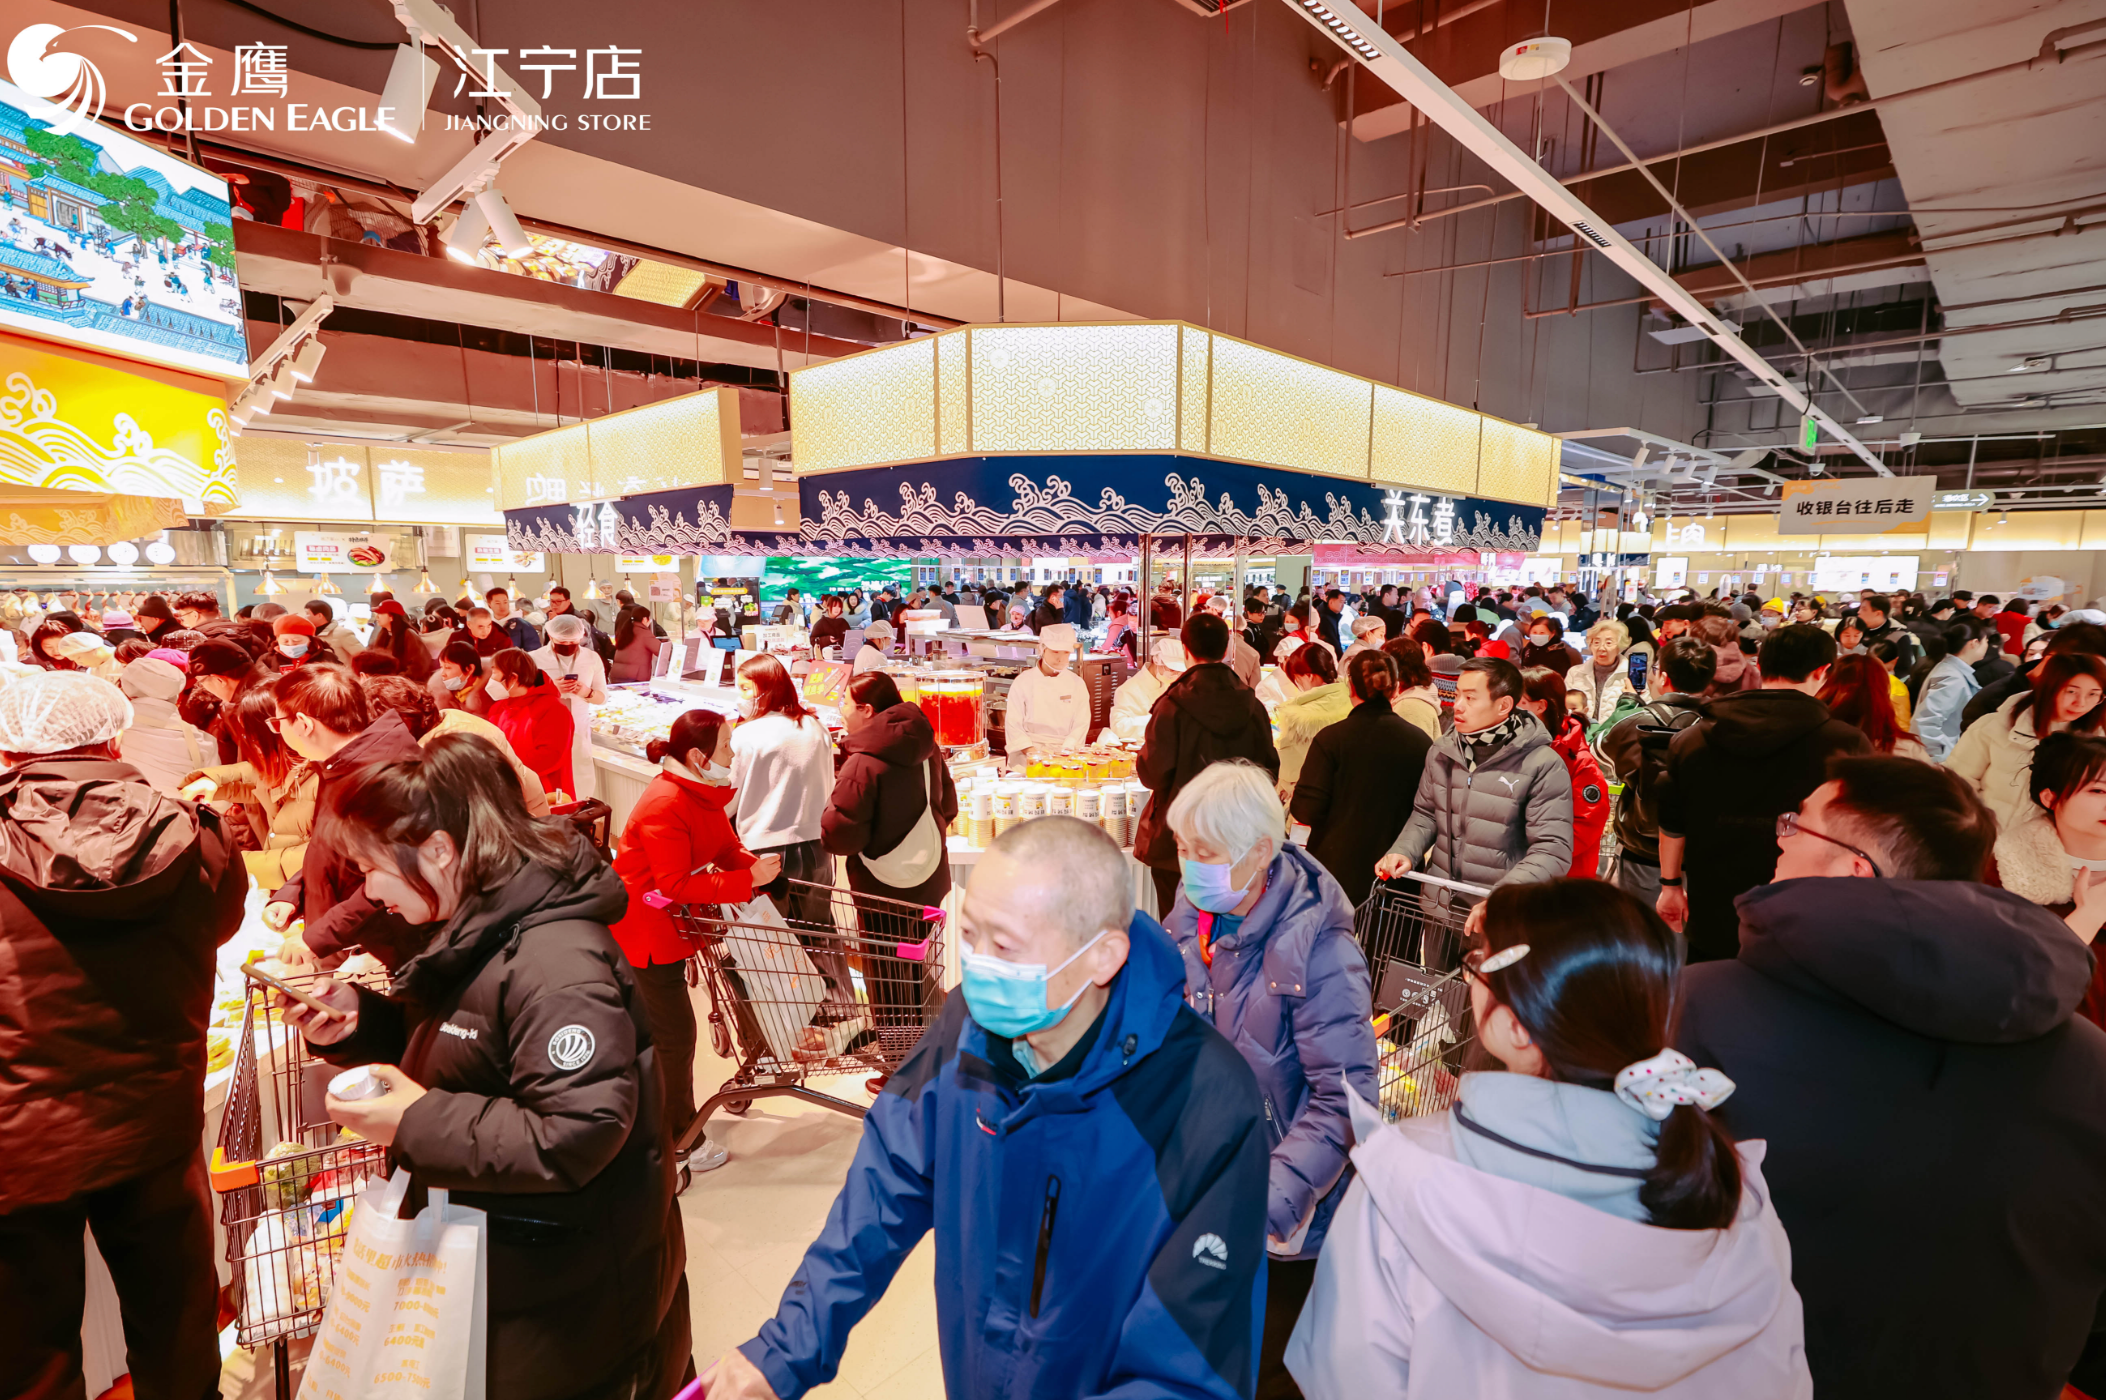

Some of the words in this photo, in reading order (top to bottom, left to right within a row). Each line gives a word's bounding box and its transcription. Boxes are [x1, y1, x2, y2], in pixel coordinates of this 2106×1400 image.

[305, 456, 427, 507] 披萨
[1796, 498, 1914, 515] 收银台往后走
[576, 501, 619, 550] 轻食
[1382, 489, 1456, 546] 关东煮
